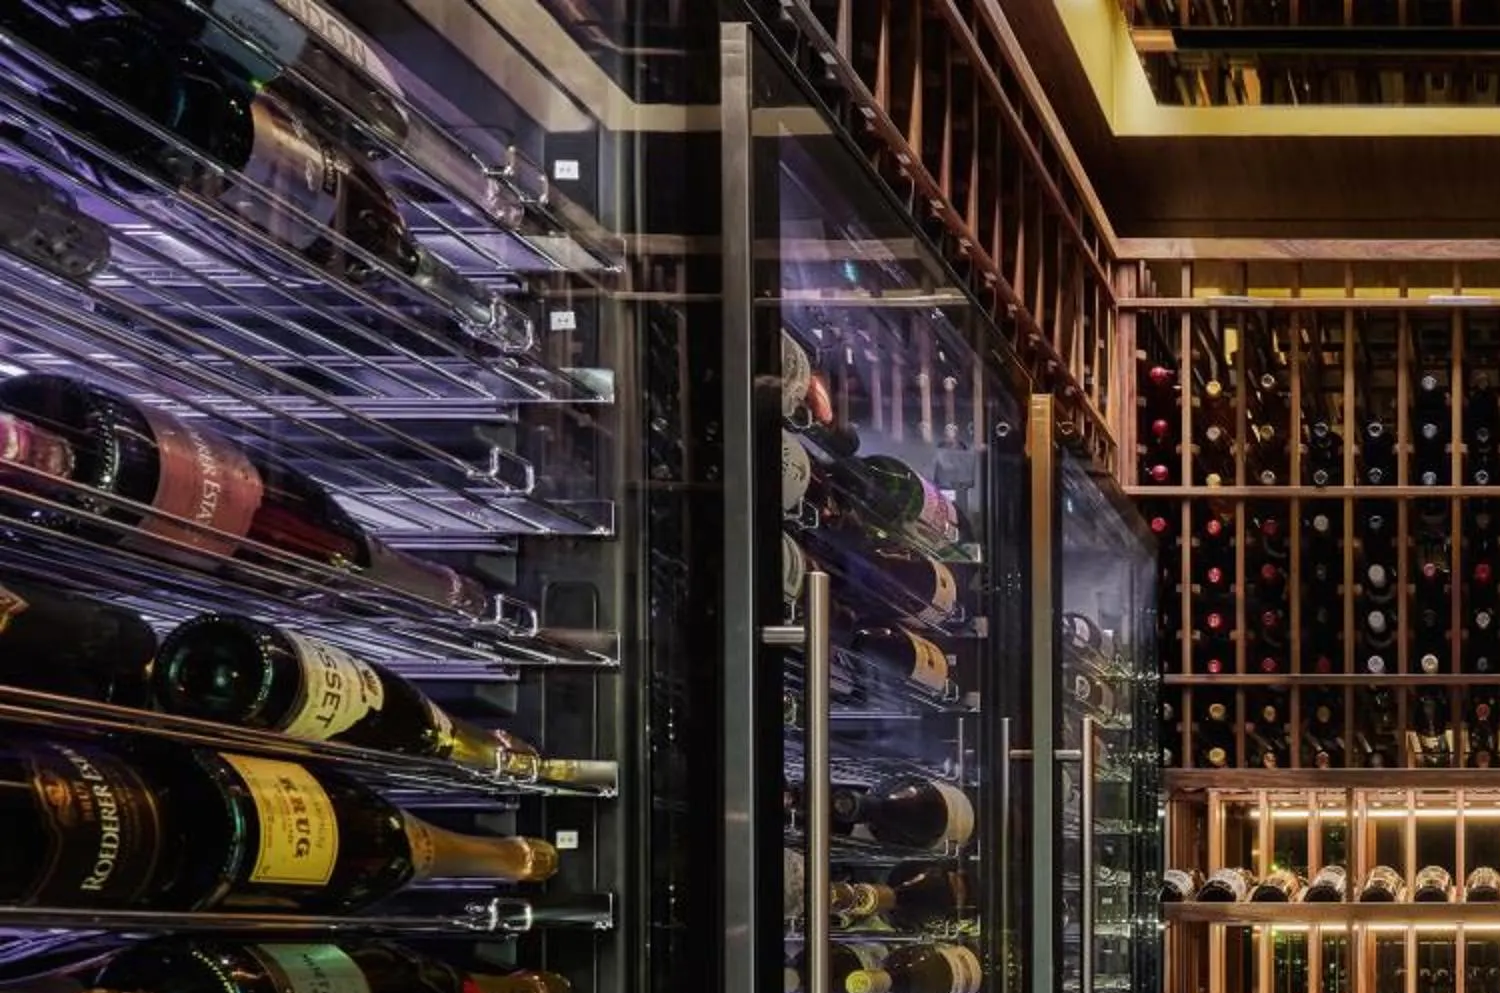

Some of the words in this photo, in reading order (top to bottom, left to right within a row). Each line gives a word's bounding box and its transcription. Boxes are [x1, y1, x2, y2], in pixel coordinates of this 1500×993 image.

[314, 645, 343, 729] SSET
[79, 784, 121, 891] ROEDERER
[278, 776, 311, 859] KRUG
